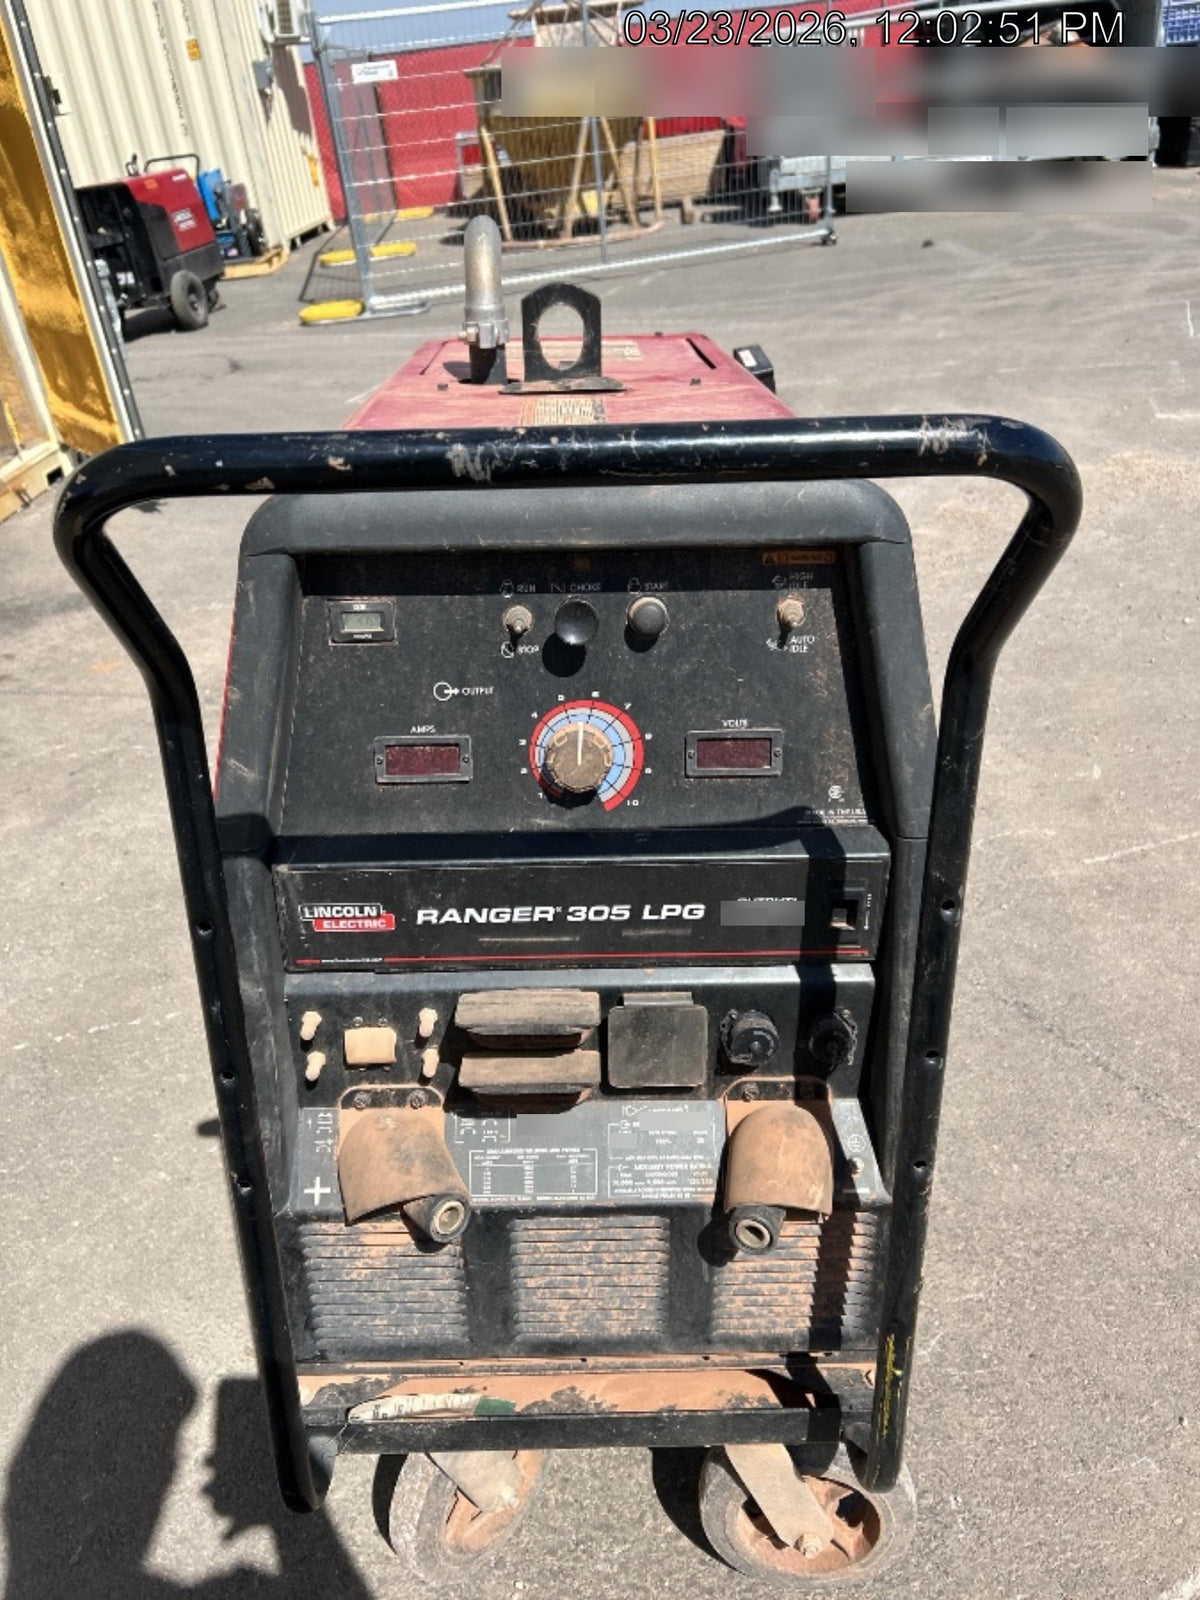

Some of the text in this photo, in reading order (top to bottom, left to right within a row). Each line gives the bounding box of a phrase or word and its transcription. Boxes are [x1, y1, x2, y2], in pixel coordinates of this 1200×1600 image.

[790, 635, 815, 645] AUTO
[461, 686, 495, 696] OUTPUT
[410, 725, 437, 734] AMPS
[302, 905, 378, 918] LINCOLN
[566, 904, 631, 922] 305
[642, 903, 706, 920] LPG
[322, 918, 387, 930] ELECTRIC
